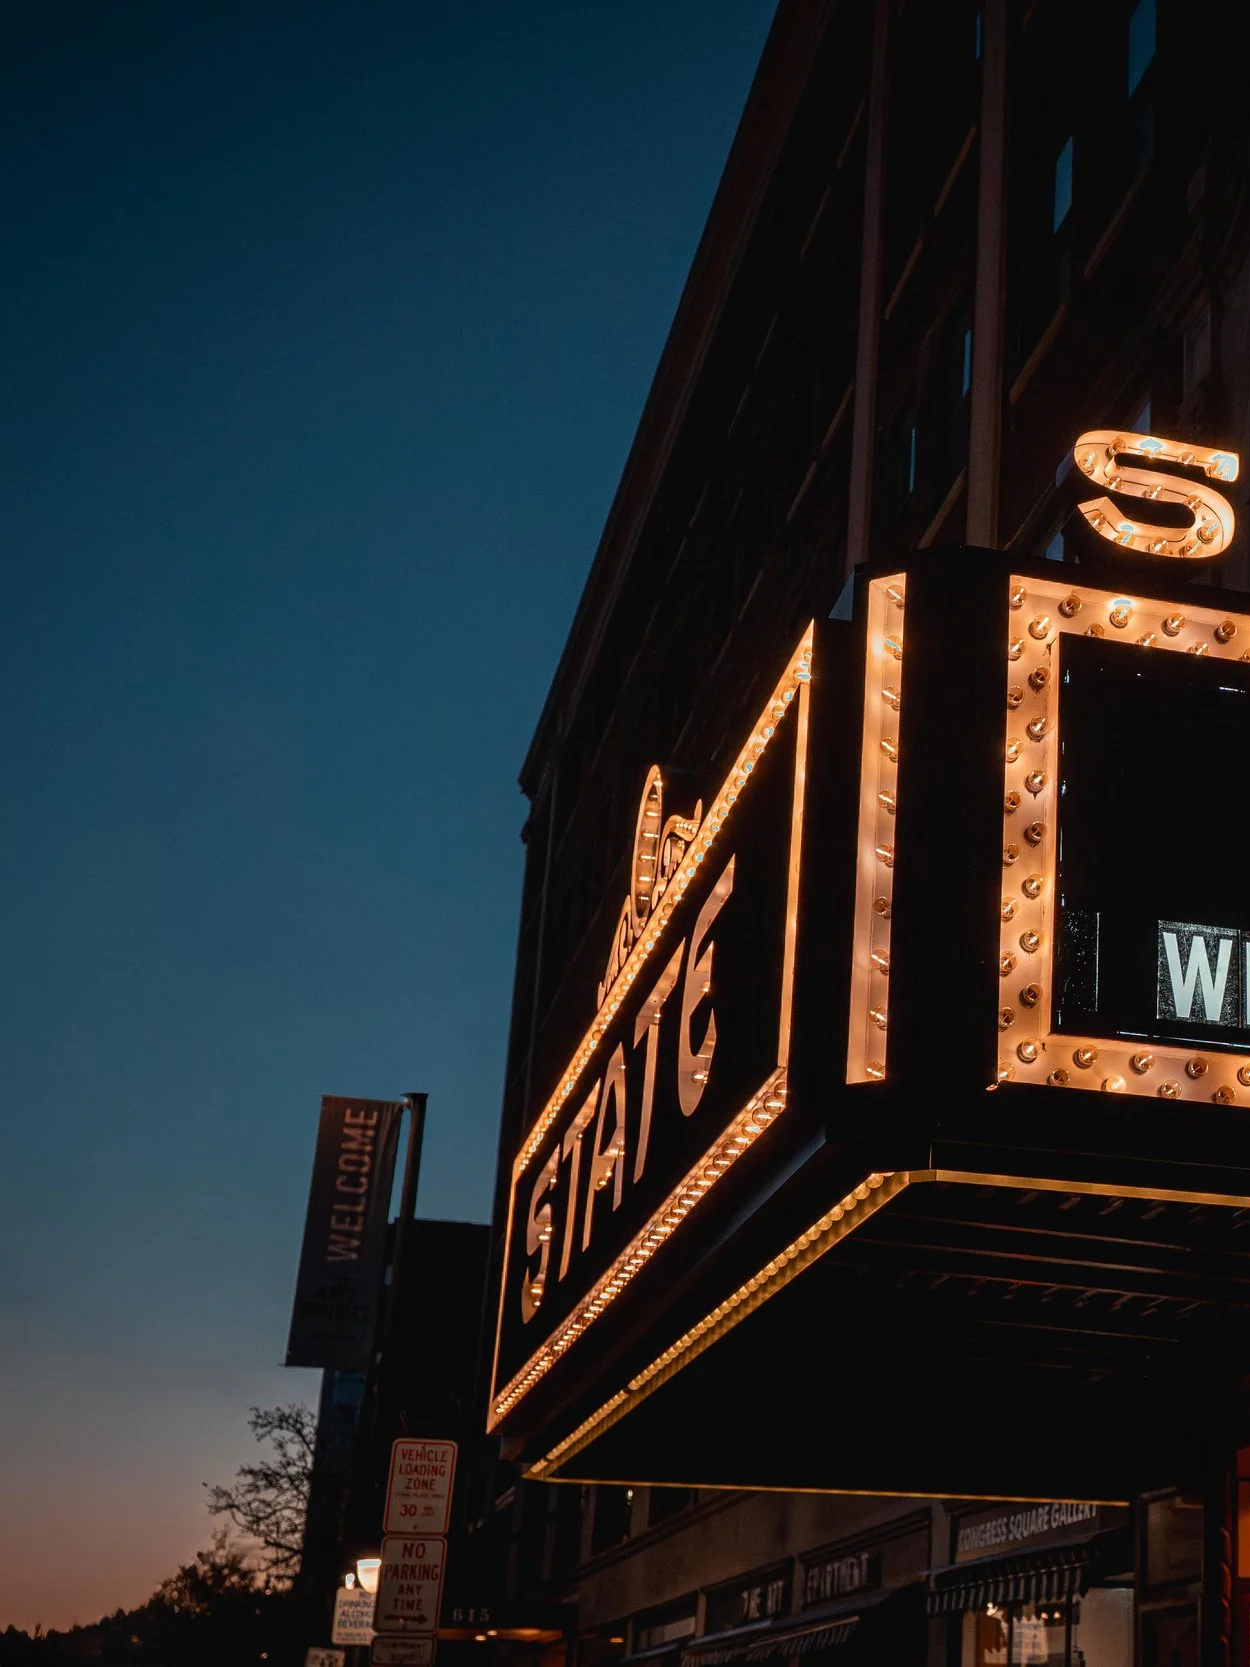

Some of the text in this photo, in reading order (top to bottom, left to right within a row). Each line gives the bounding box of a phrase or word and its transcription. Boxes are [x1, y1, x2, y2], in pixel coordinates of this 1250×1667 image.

[521, 852, 736, 1324] STATE
[325, 1107, 378, 1261] WELCOME
[401, 1448, 448, 1463] VEHICLE
[398, 1463, 446, 1477] LOADING
[405, 1477, 436, 1491] ZONE
[399, 1503, 417, 1517] 30
[958, 1516, 1008, 1551] CONGRESS
[1008, 1504, 1050, 1541] SQUARE
[402, 1542, 426, 1559] NO
[383, 1563, 440, 1581] PARKING
[397, 1583, 423, 1595] ANY
[393, 1598, 423, 1611] TIME
